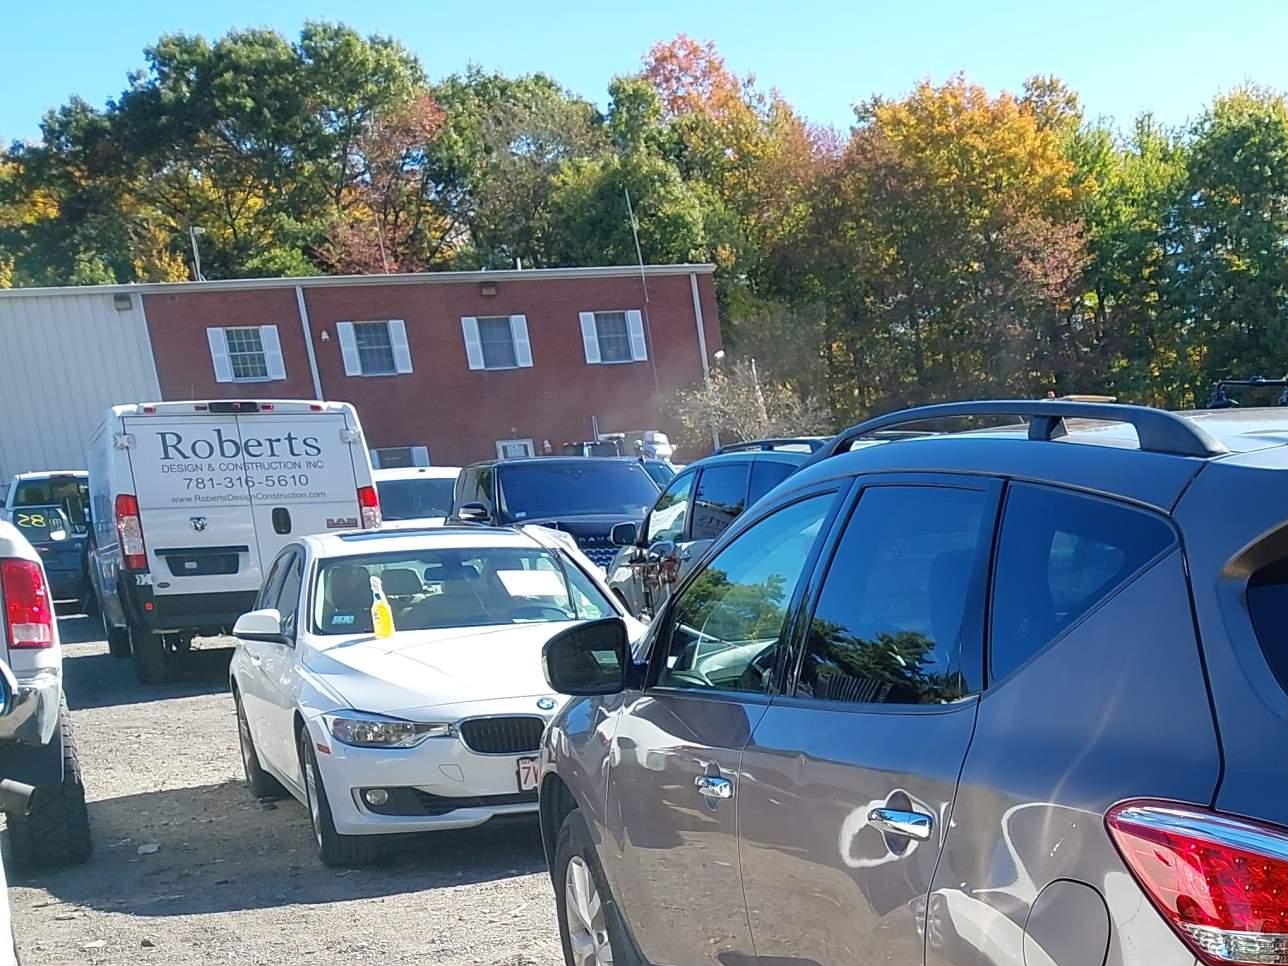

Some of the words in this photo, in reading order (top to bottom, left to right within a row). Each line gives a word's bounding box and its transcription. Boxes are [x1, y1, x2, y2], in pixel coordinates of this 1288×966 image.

[156, 429, 322, 460] Roberts
[161, 463, 203, 473] DESIGN
[207, 463, 215, 472] &
[218, 460, 302, 472] CONSTRUCTION
[306, 460, 324, 469] INC
[183, 474, 309, 490] 781-316-5610
[170, 491, 327, 504] www.RobertsDesignConstruction.com
